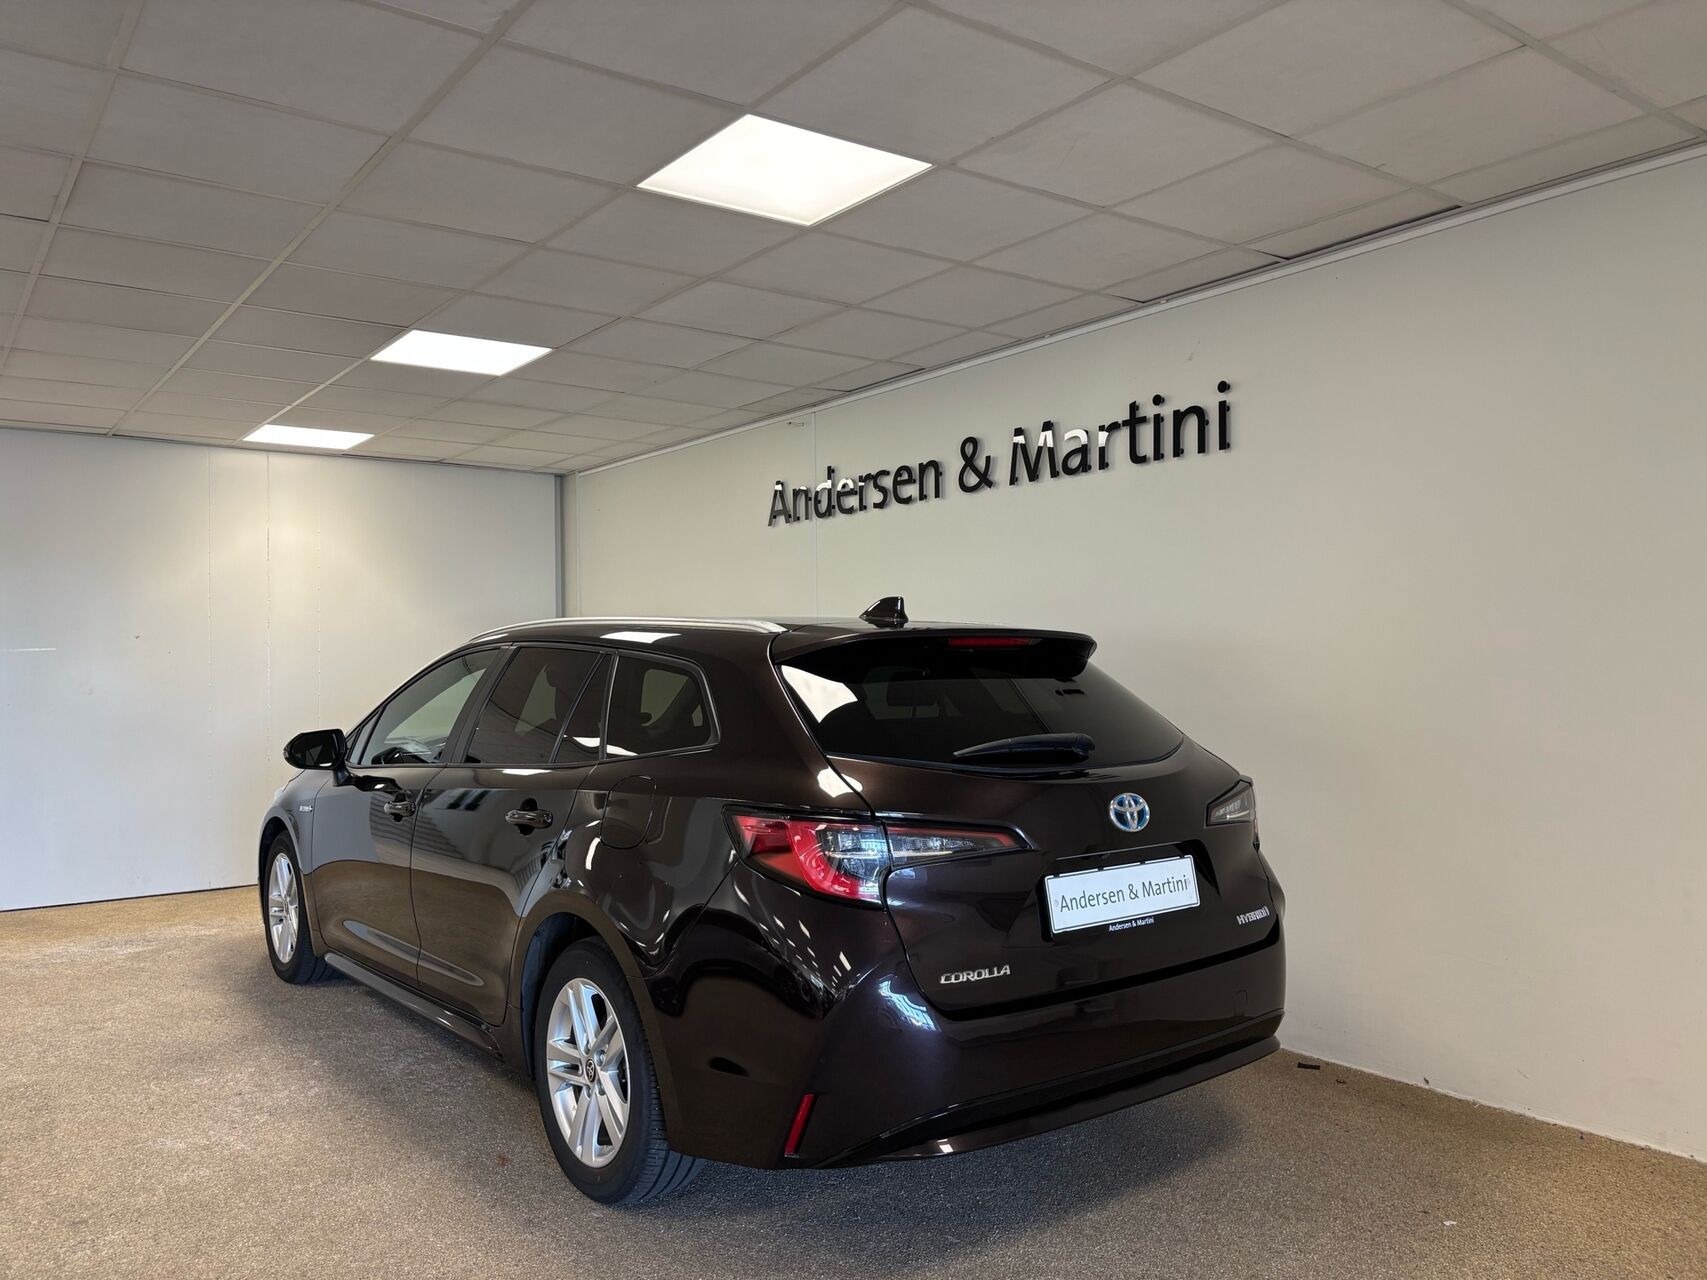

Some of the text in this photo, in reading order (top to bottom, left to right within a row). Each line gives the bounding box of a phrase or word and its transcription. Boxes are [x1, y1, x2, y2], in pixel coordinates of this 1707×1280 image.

[768, 380, 1231, 527] Andersen & Martini
[1060, 874, 1188, 912] Andersen & Martini
[1109, 922, 1132, 931] Andersen
[1137, 916, 1155, 926] Martini
[940, 964, 1011, 984] COROLLA
